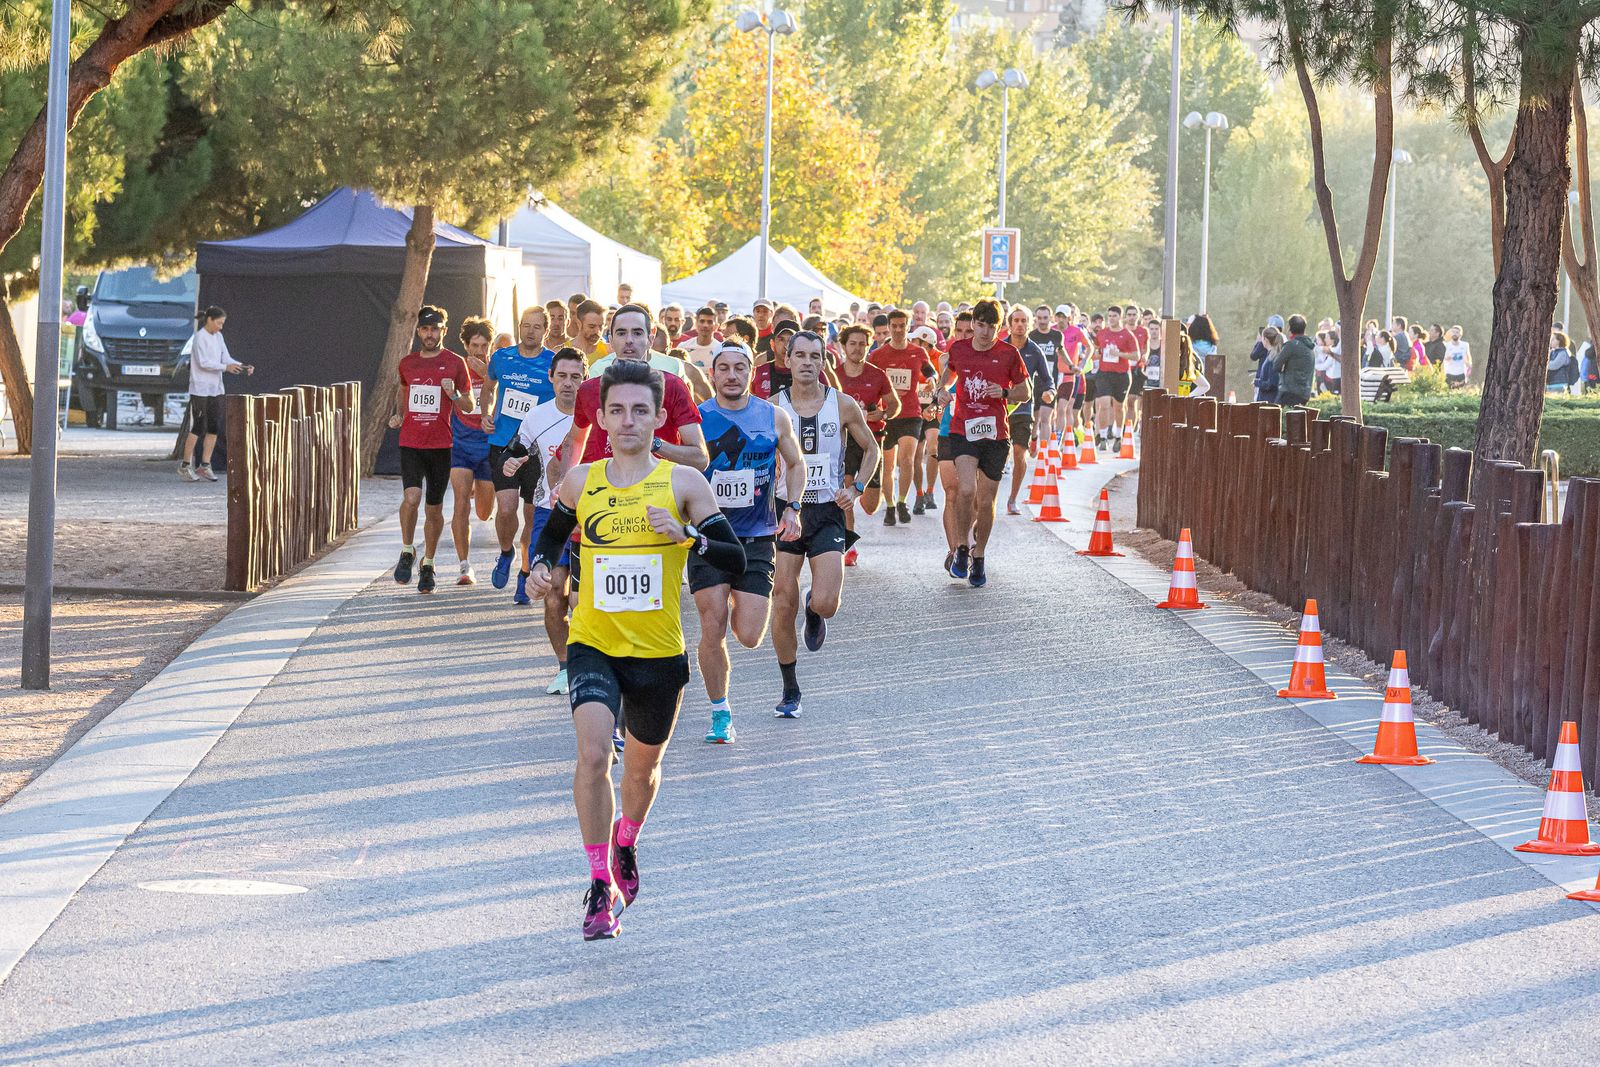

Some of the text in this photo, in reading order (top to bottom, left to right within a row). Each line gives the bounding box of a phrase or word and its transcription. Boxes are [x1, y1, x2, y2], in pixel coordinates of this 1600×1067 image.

[413, 394, 435, 405] 0158
[508, 398, 531, 413] 0116
[970, 423, 992, 434] 0208
[716, 482, 747, 497] 0013
[612, 516, 646, 525] CLÍNICA
[611, 525, 655, 534] MENORC
[605, 574, 651, 595] 0019
